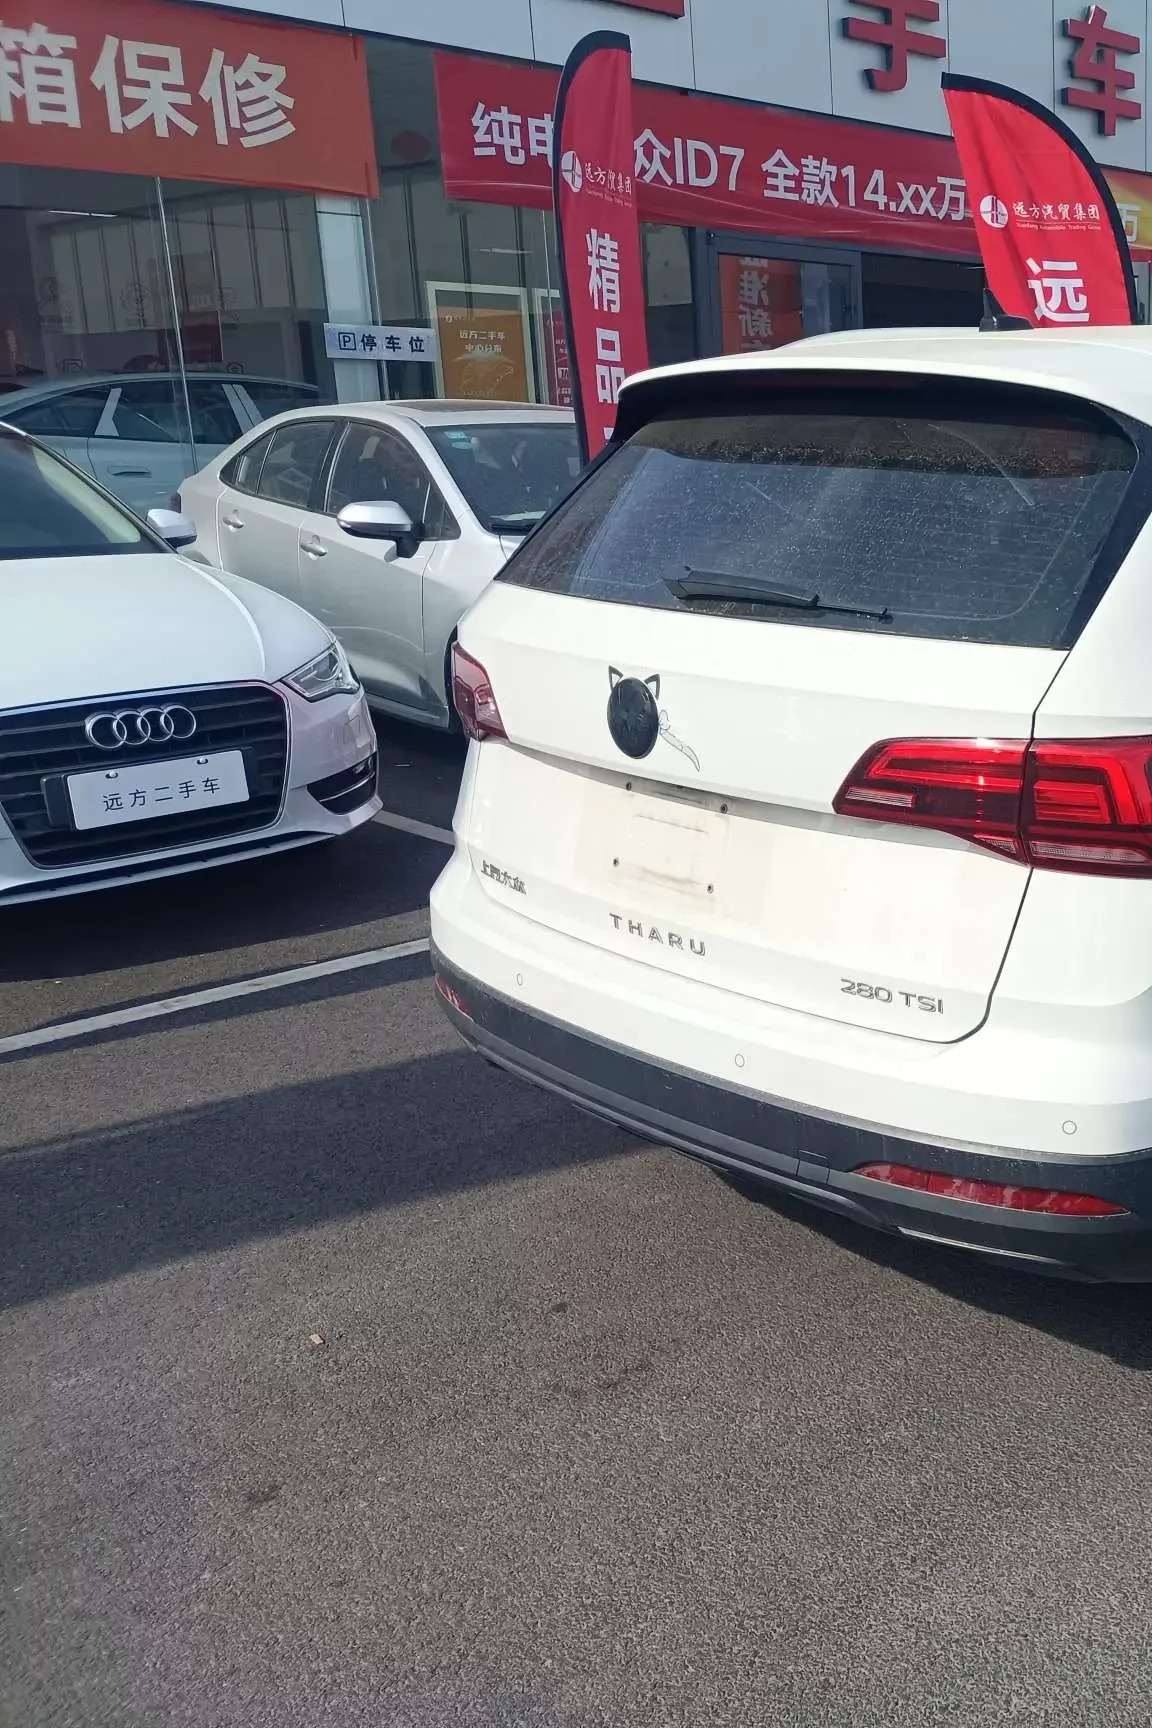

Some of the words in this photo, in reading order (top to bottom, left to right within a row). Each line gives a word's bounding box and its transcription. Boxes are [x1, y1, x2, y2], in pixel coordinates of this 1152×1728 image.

[1026, 257, 1090, 323] 远
[102, 777, 221, 812] 远方二手车
[608, 912, 706, 957] THARU
[840, 977, 893, 1004] 280
[898, 990, 945, 1015] TSI
